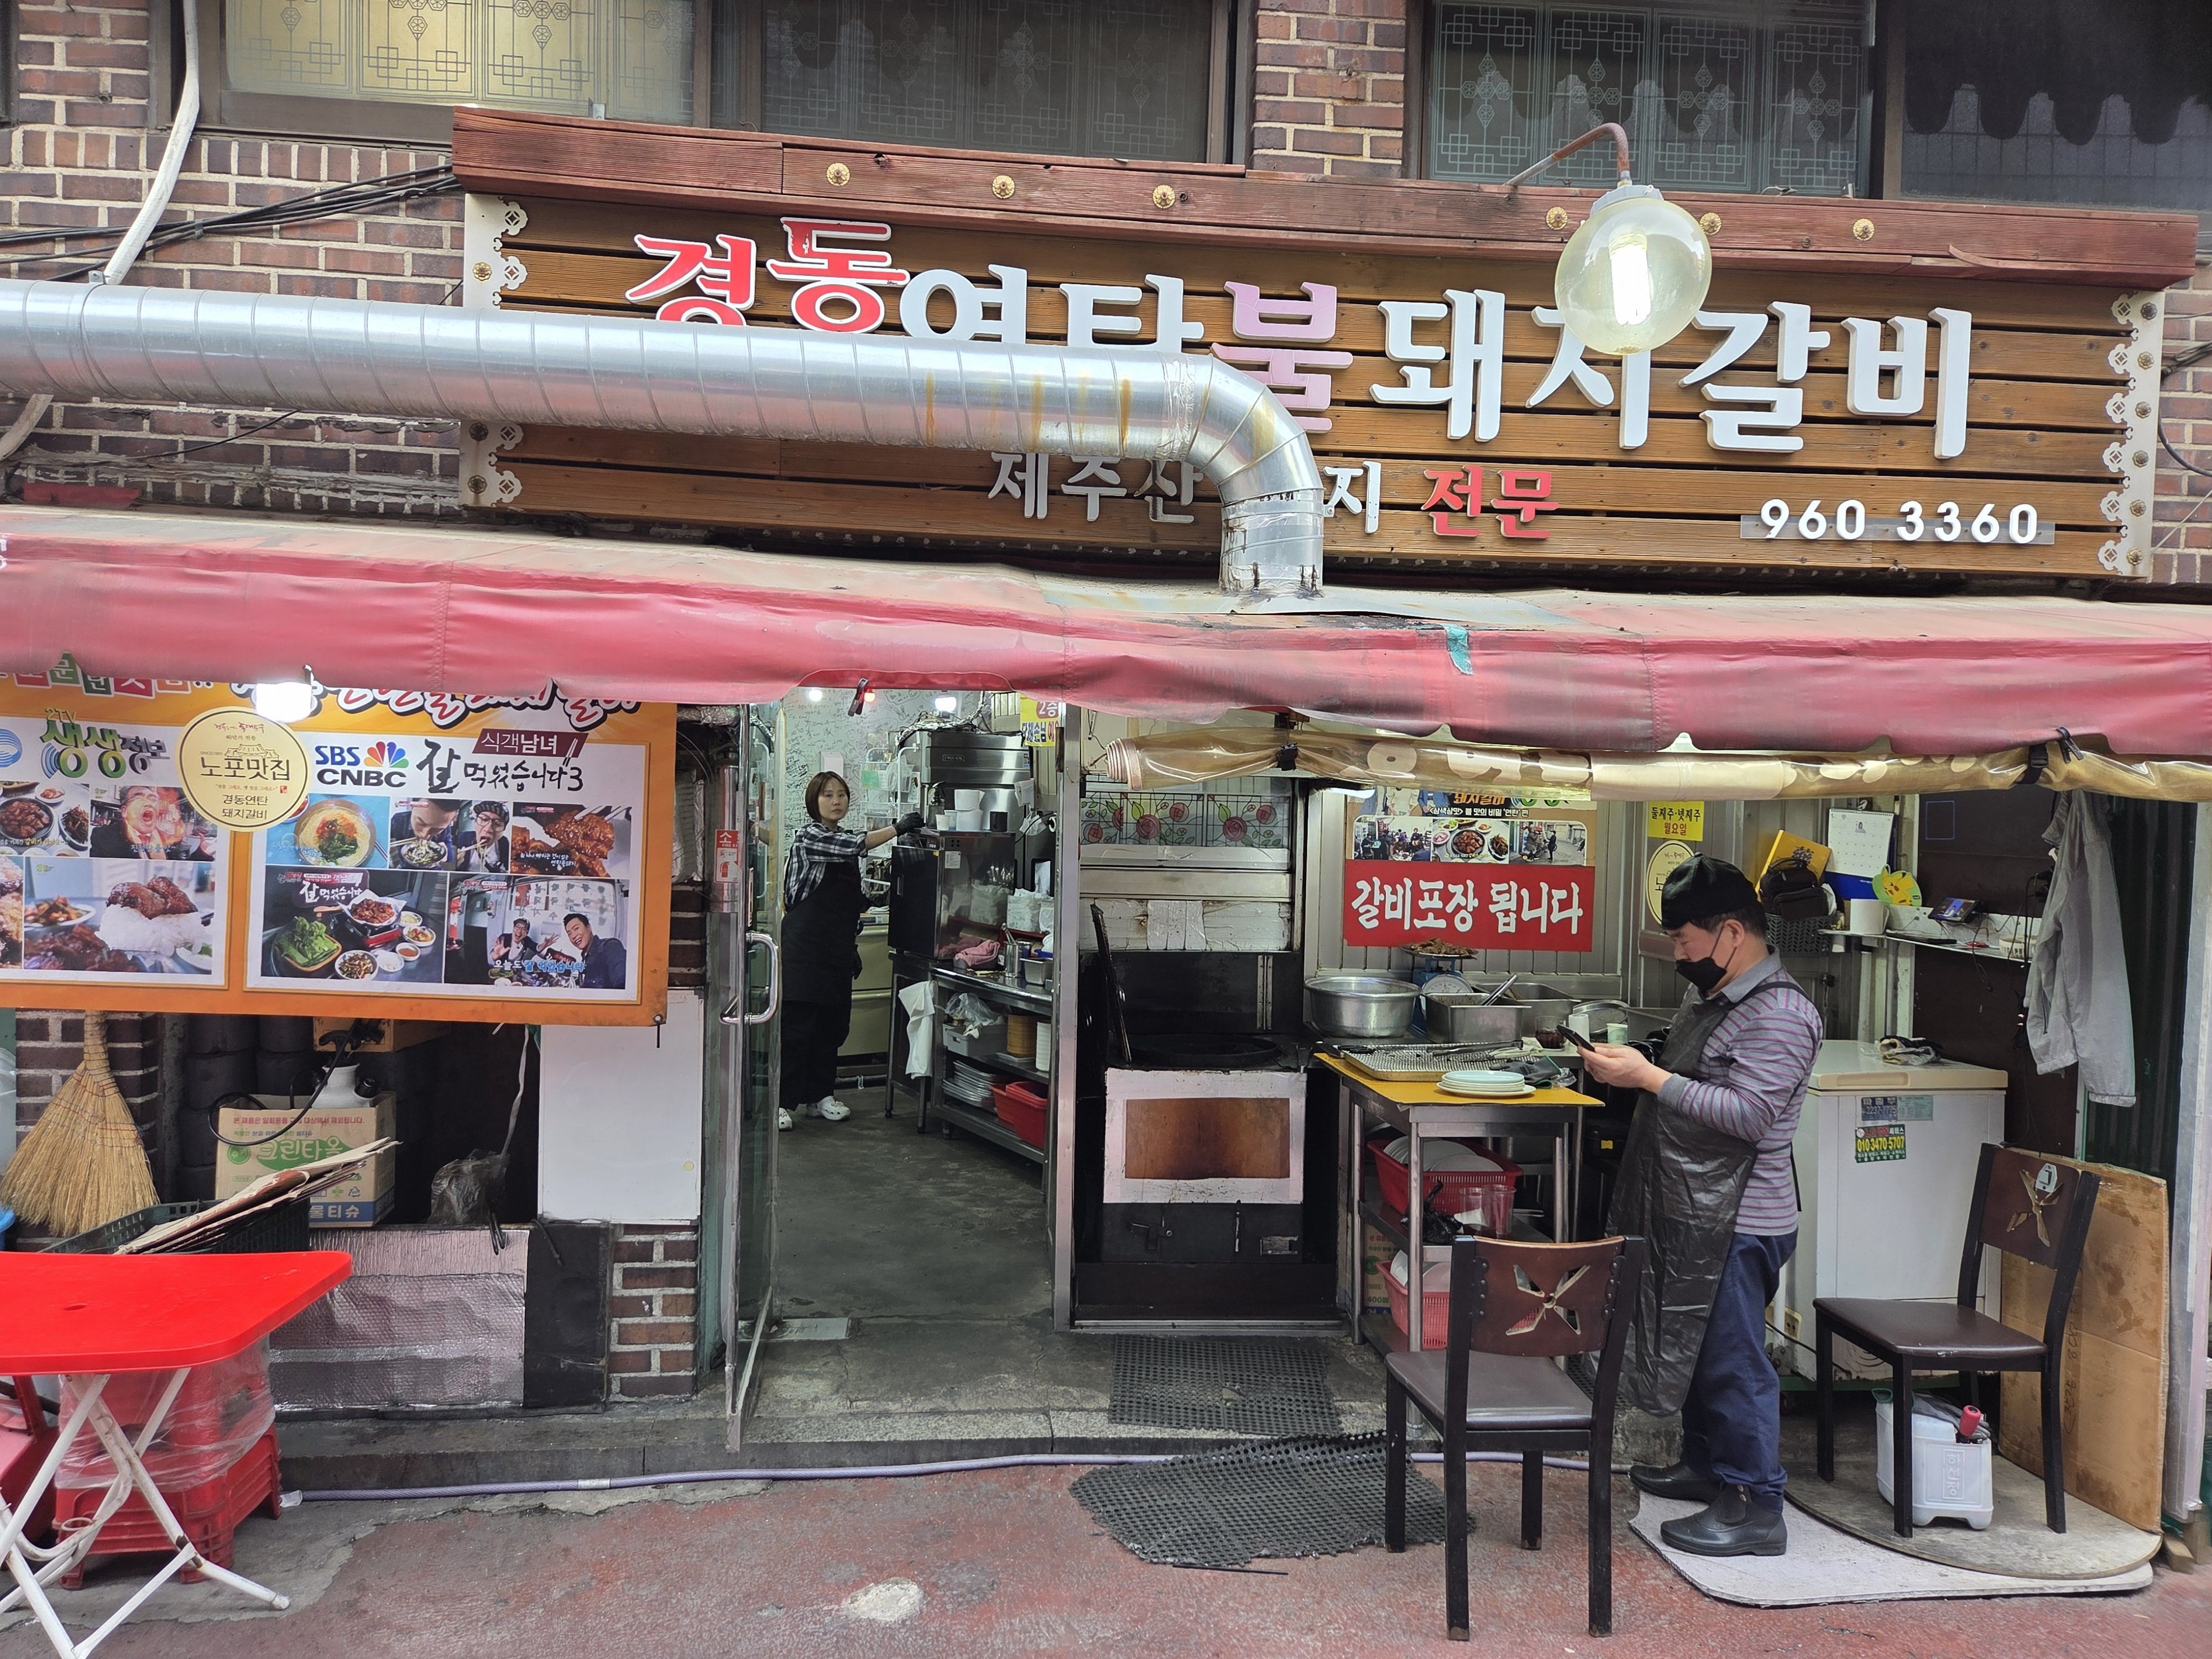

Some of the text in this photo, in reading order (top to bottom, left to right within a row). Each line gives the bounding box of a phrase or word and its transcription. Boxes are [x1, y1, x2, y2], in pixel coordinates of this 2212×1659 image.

[1422, 466, 1558, 539] 전문
[1761, 498, 2038, 545] 960 3360
[45, 708, 76, 722] 2TV
[481, 733, 558, 755] 식객남녀
[315, 745, 360, 766] SBS
[200, 757, 290, 781] 노포맛집
[416, 739, 461, 794] 잘
[317, 768, 407, 788] CNBC
[222, 794, 269, 806] 경동연탄
[222, 808, 268, 820] 돼지갈비
[1488, 808, 1502, 817] 비밀
[1664, 822, 1687, 836] 월요일
[299, 880, 320, 903] 잘
[1351, 876, 1583, 935] 갈비포장 됩니다
[493, 959, 522, 970] 오늘도
[1857, 1136, 1905, 1152] 010-3470-5707
[309, 1205, 360, 1219] 물티슈
[1947, 1453, 1961, 1496] 하선정
